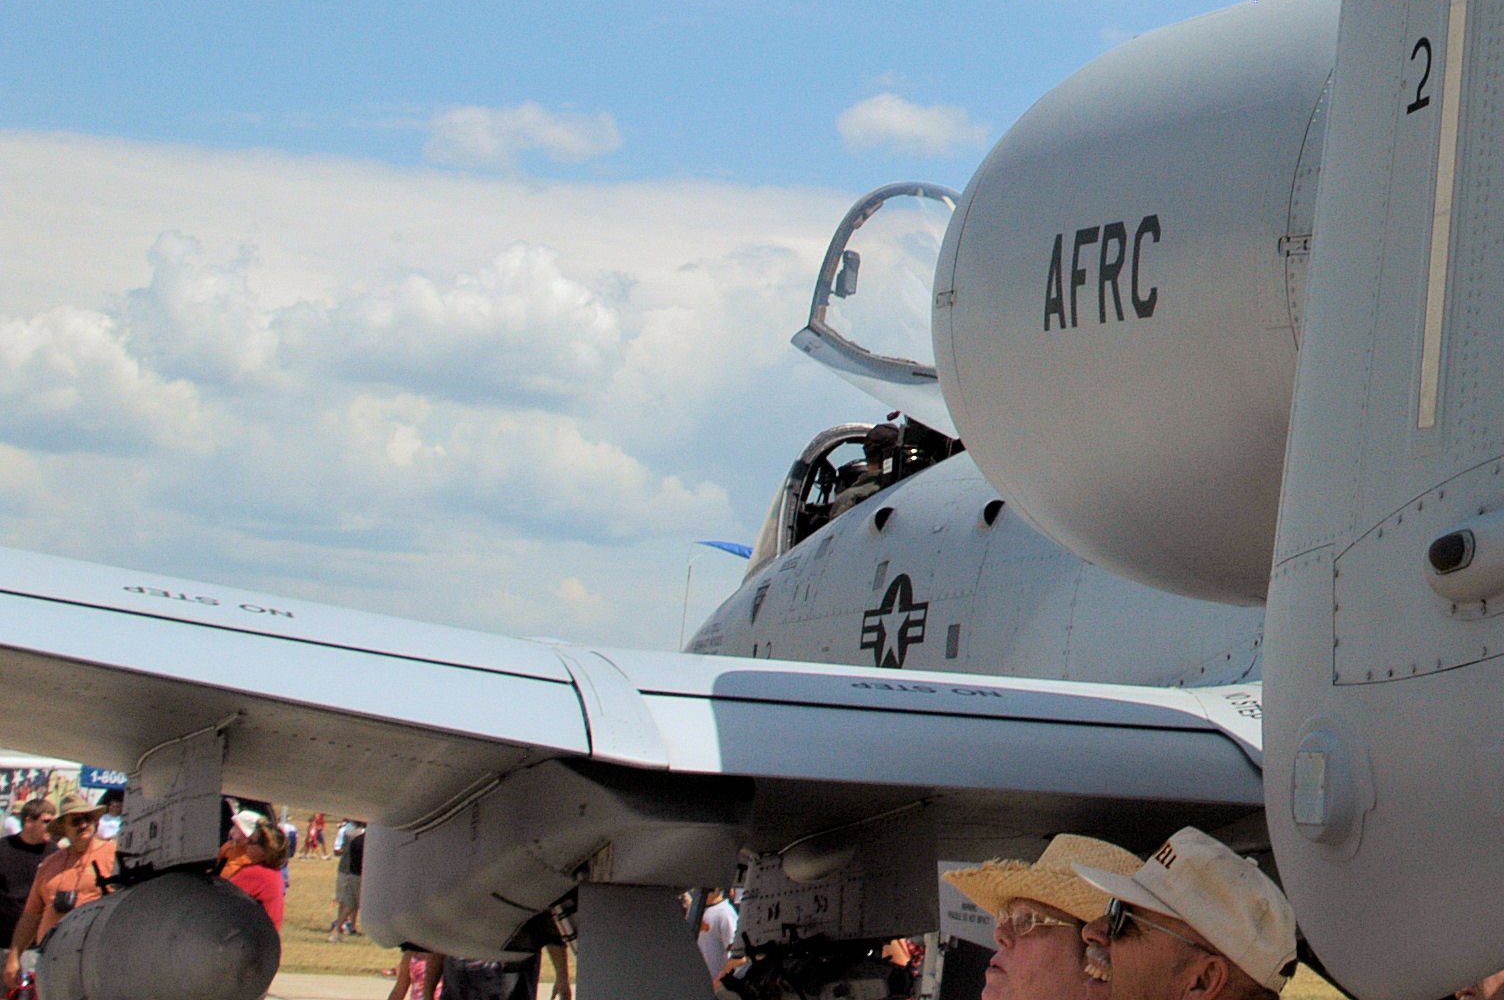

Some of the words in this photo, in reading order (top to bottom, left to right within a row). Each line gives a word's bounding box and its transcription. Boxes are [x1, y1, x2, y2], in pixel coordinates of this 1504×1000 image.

[1407, 37, 1432, 114] 2
[1044, 213, 1161, 332] AFRC
[123, 586, 219, 606] STEP
[239, 603, 294, 618] NO
[851, 682, 937, 694] STEP
[952, 688, 1002, 698] NO
